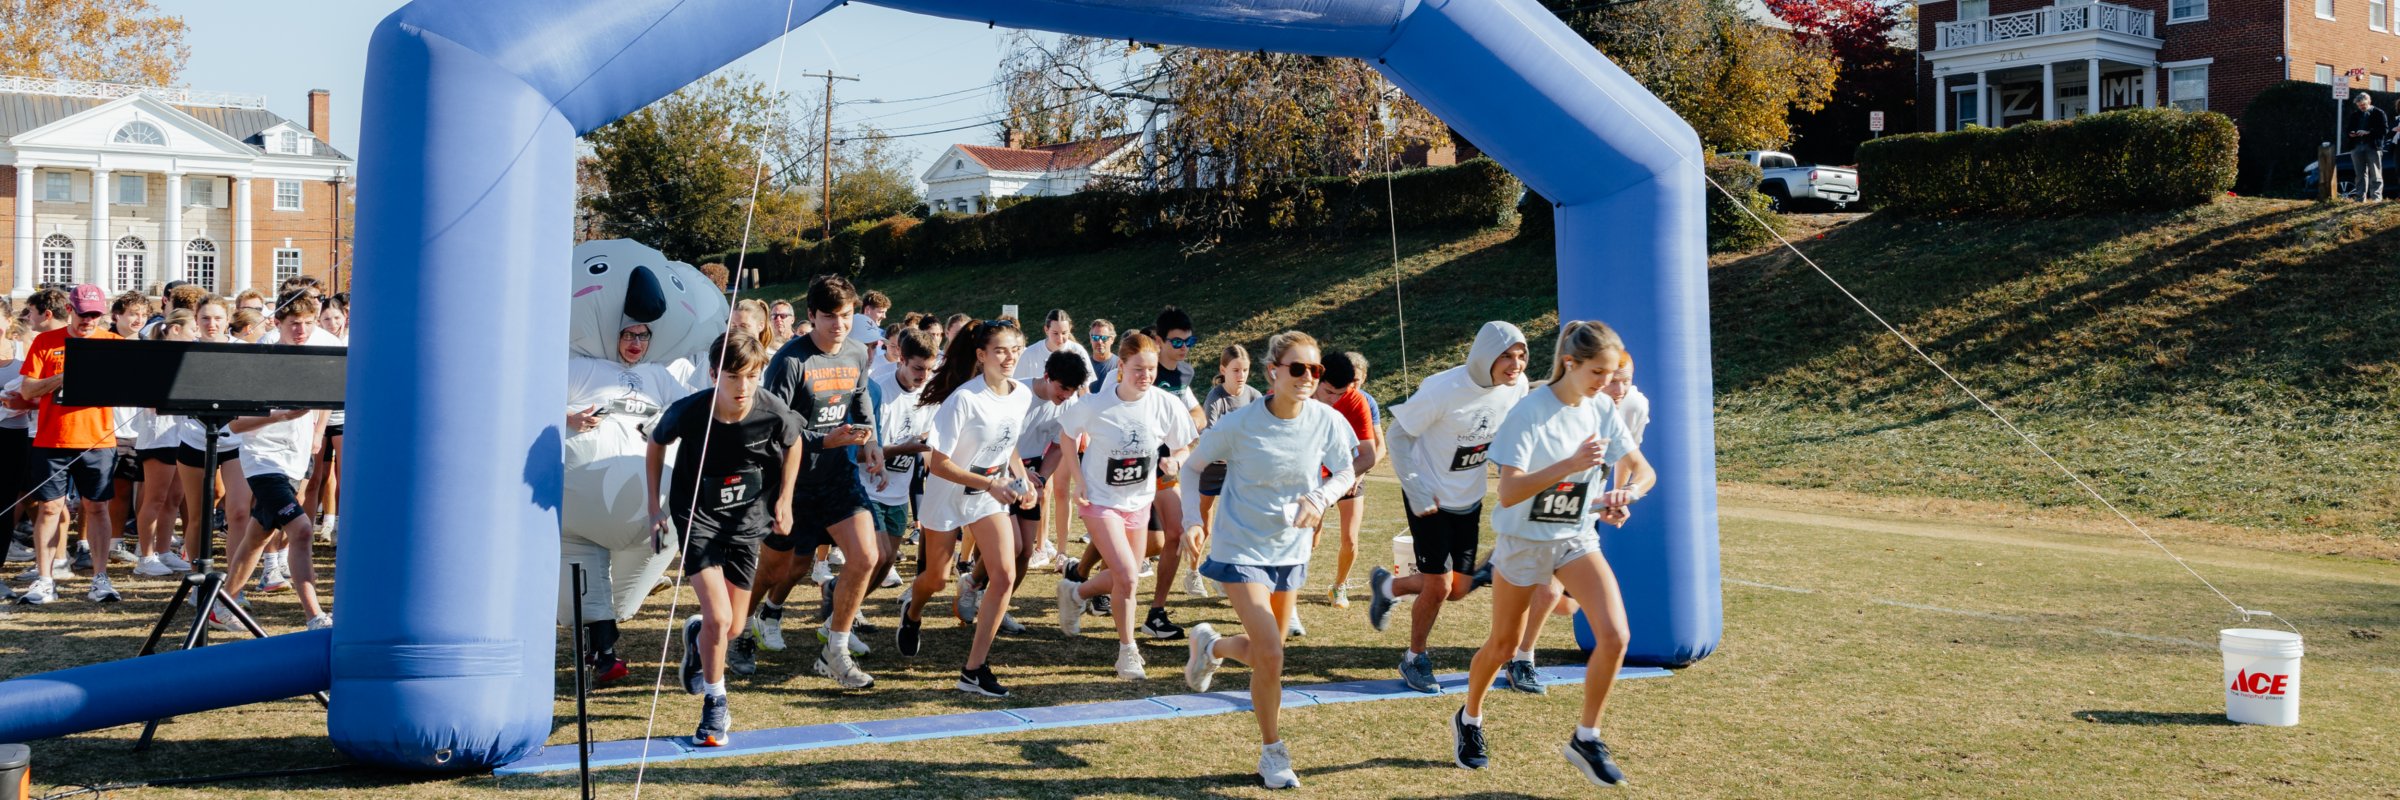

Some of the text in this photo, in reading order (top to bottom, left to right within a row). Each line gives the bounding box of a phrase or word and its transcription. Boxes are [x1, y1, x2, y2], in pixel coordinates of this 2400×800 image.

[2003, 86, 2038, 117] Z
[804, 367, 859, 381] PRINCETON
[817, 404, 846, 422] 390
[892, 454, 914, 468] 126
[1113, 465, 1142, 481] 321
[720, 484, 746, 504] 57
[1543, 494, 1580, 516] 194
[2230, 667, 2288, 695] ACE
